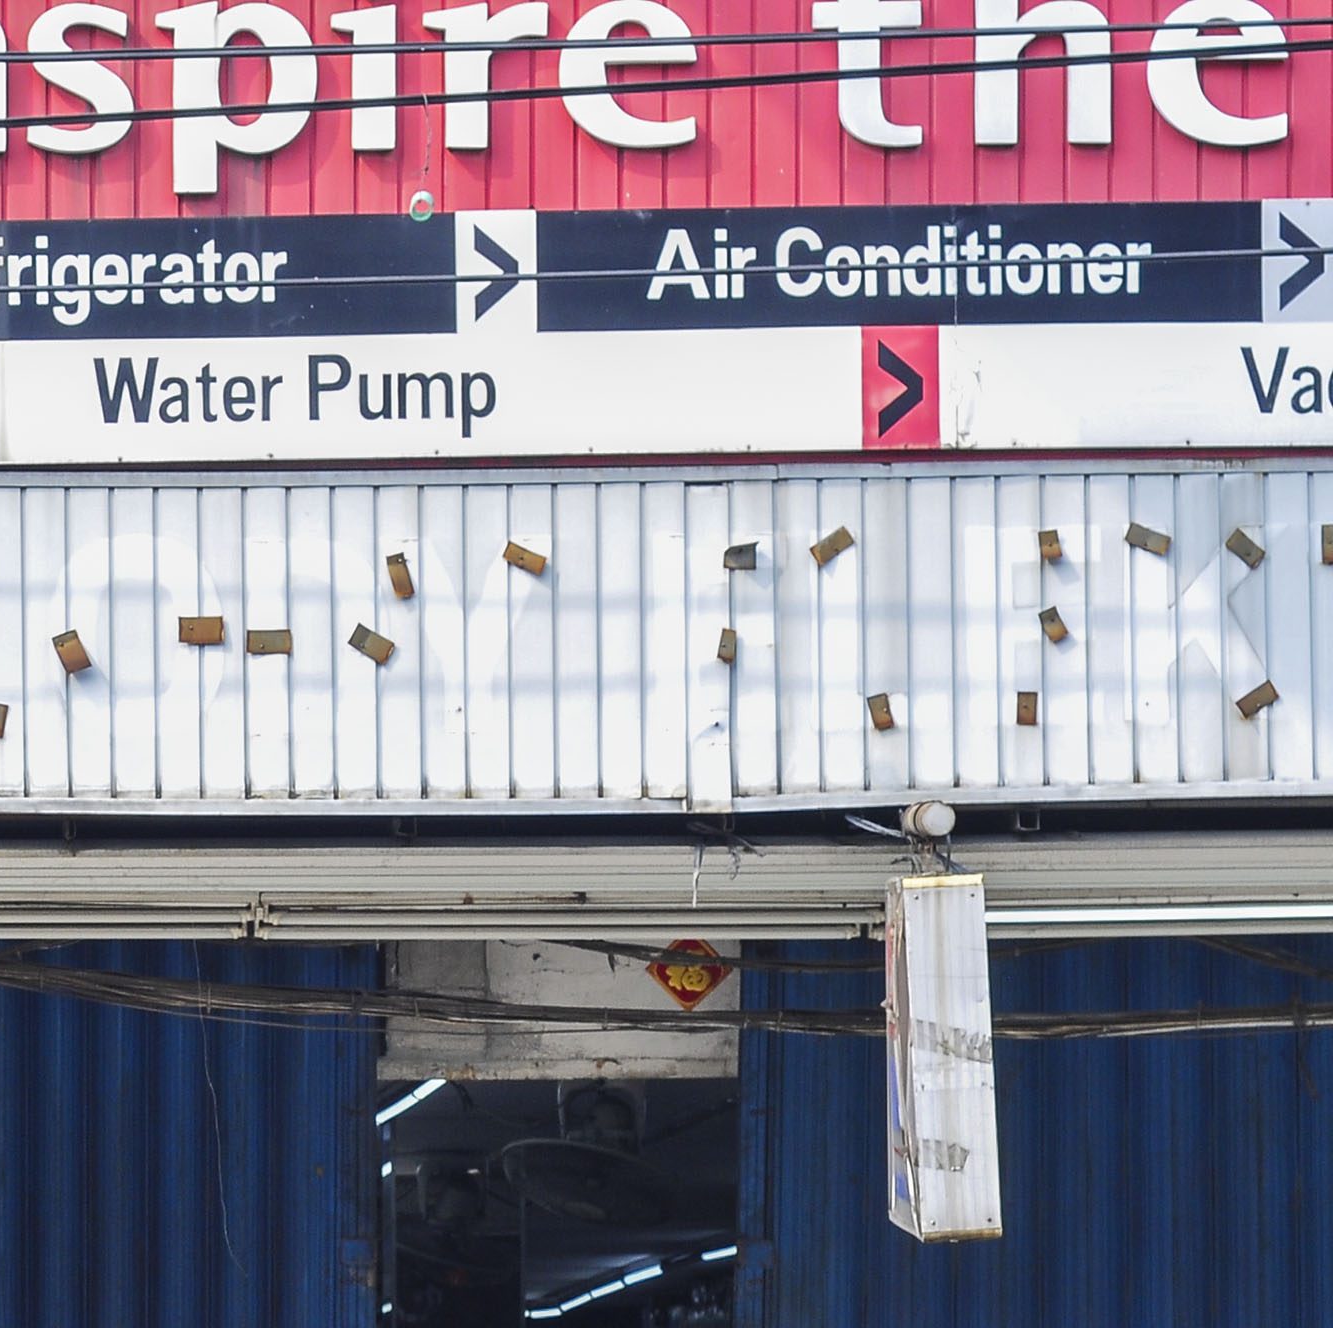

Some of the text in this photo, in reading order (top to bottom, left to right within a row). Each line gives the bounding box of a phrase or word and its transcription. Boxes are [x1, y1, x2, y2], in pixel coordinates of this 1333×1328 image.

[813, 0, 1289, 148] the
[647, 225, 1151, 301] Air Conditioner
[94, 353, 497, 438] Water Pump
[1240, 346, 1333, 414] Va
